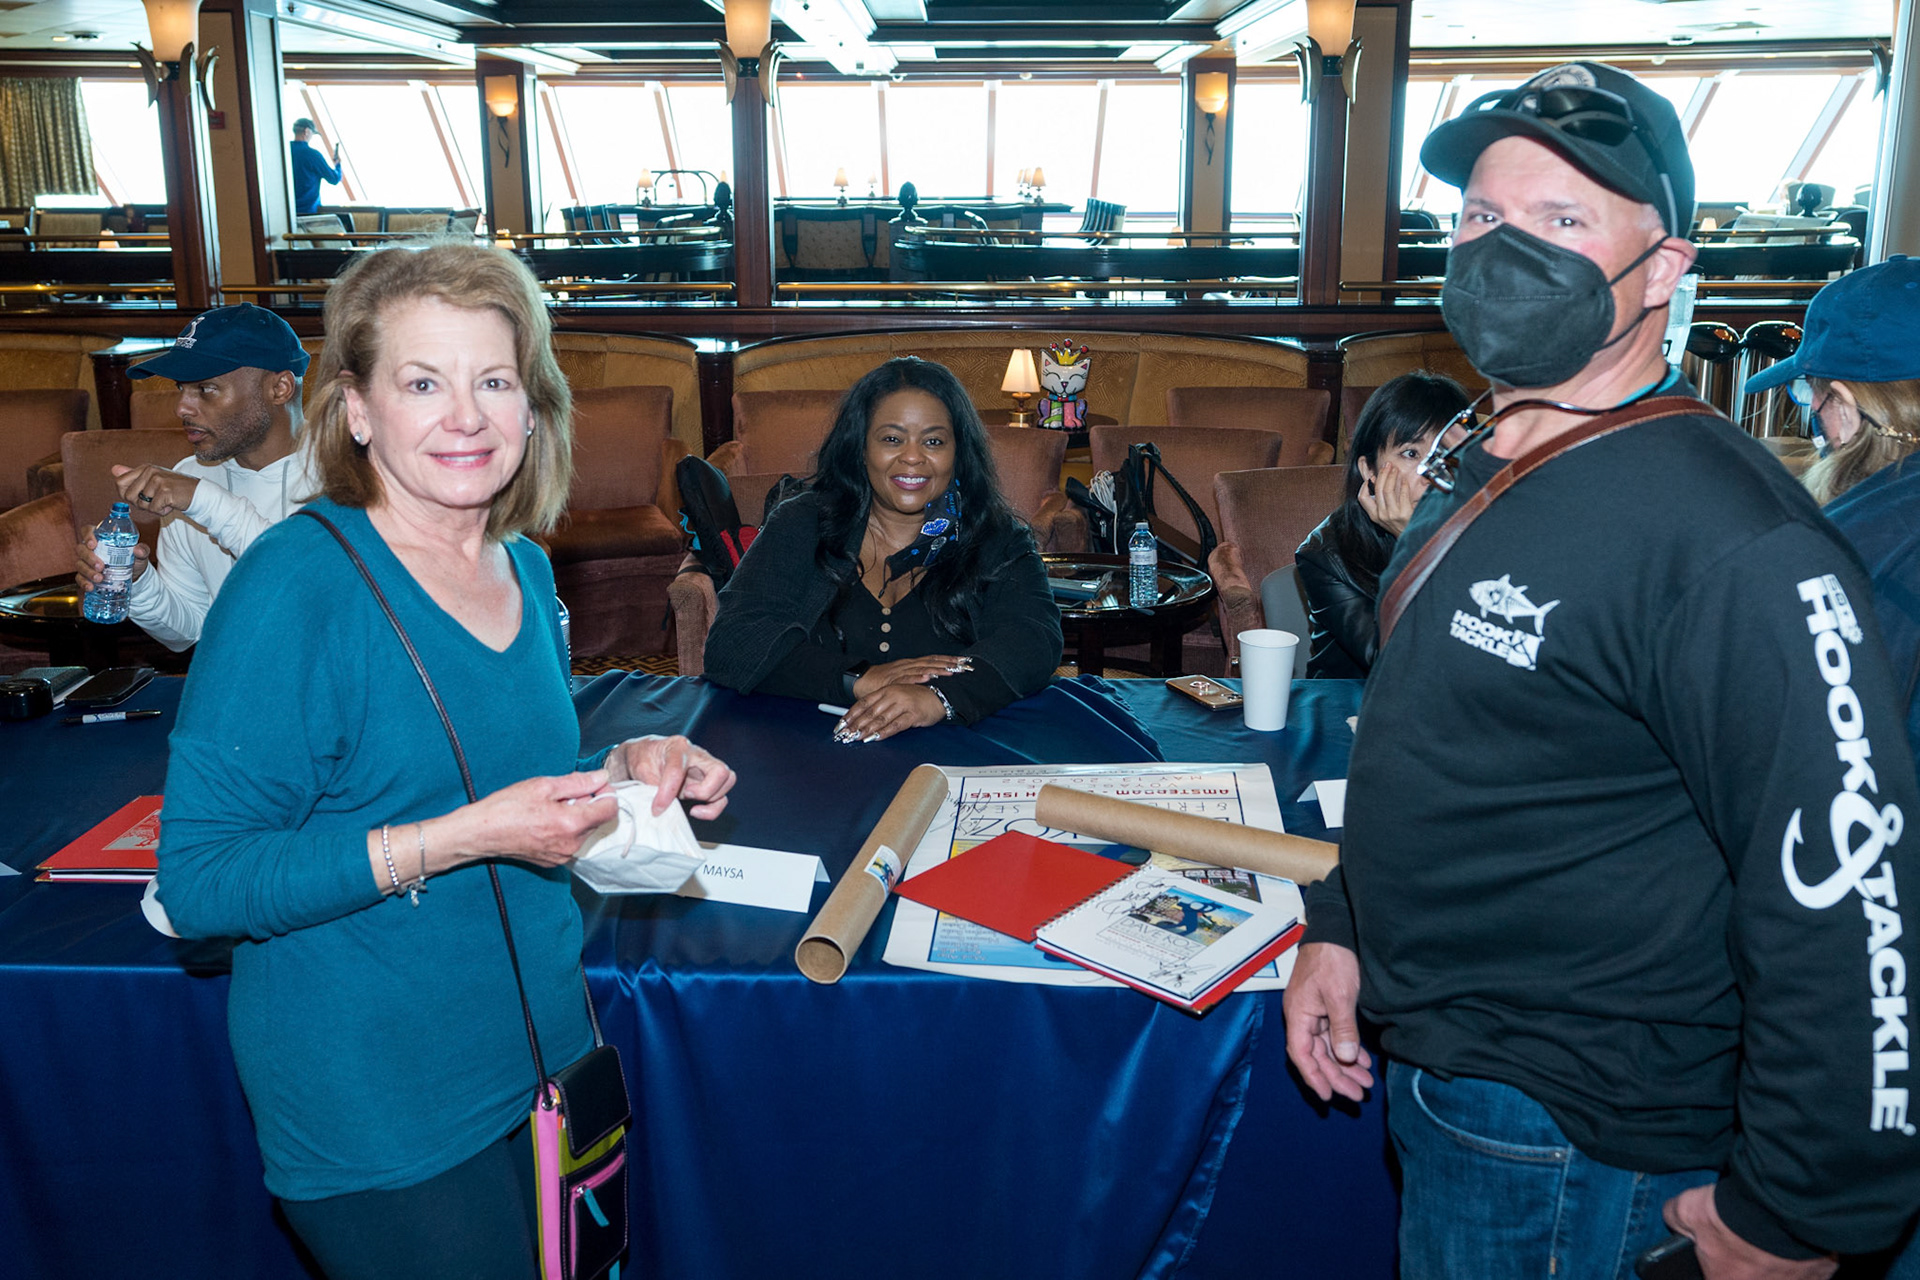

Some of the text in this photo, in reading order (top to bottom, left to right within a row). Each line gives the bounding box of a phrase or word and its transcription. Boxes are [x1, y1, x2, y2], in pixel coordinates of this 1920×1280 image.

[1450, 621, 1510, 659] TACKLE
[1453, 609, 1513, 645] HOOK
[1781, 575, 1910, 1132] HOOK & TACKLE
[703, 864, 744, 880] MAYSA
[1120, 917, 1166, 938] DAVE
[1163, 934, 1202, 952] KOZ
